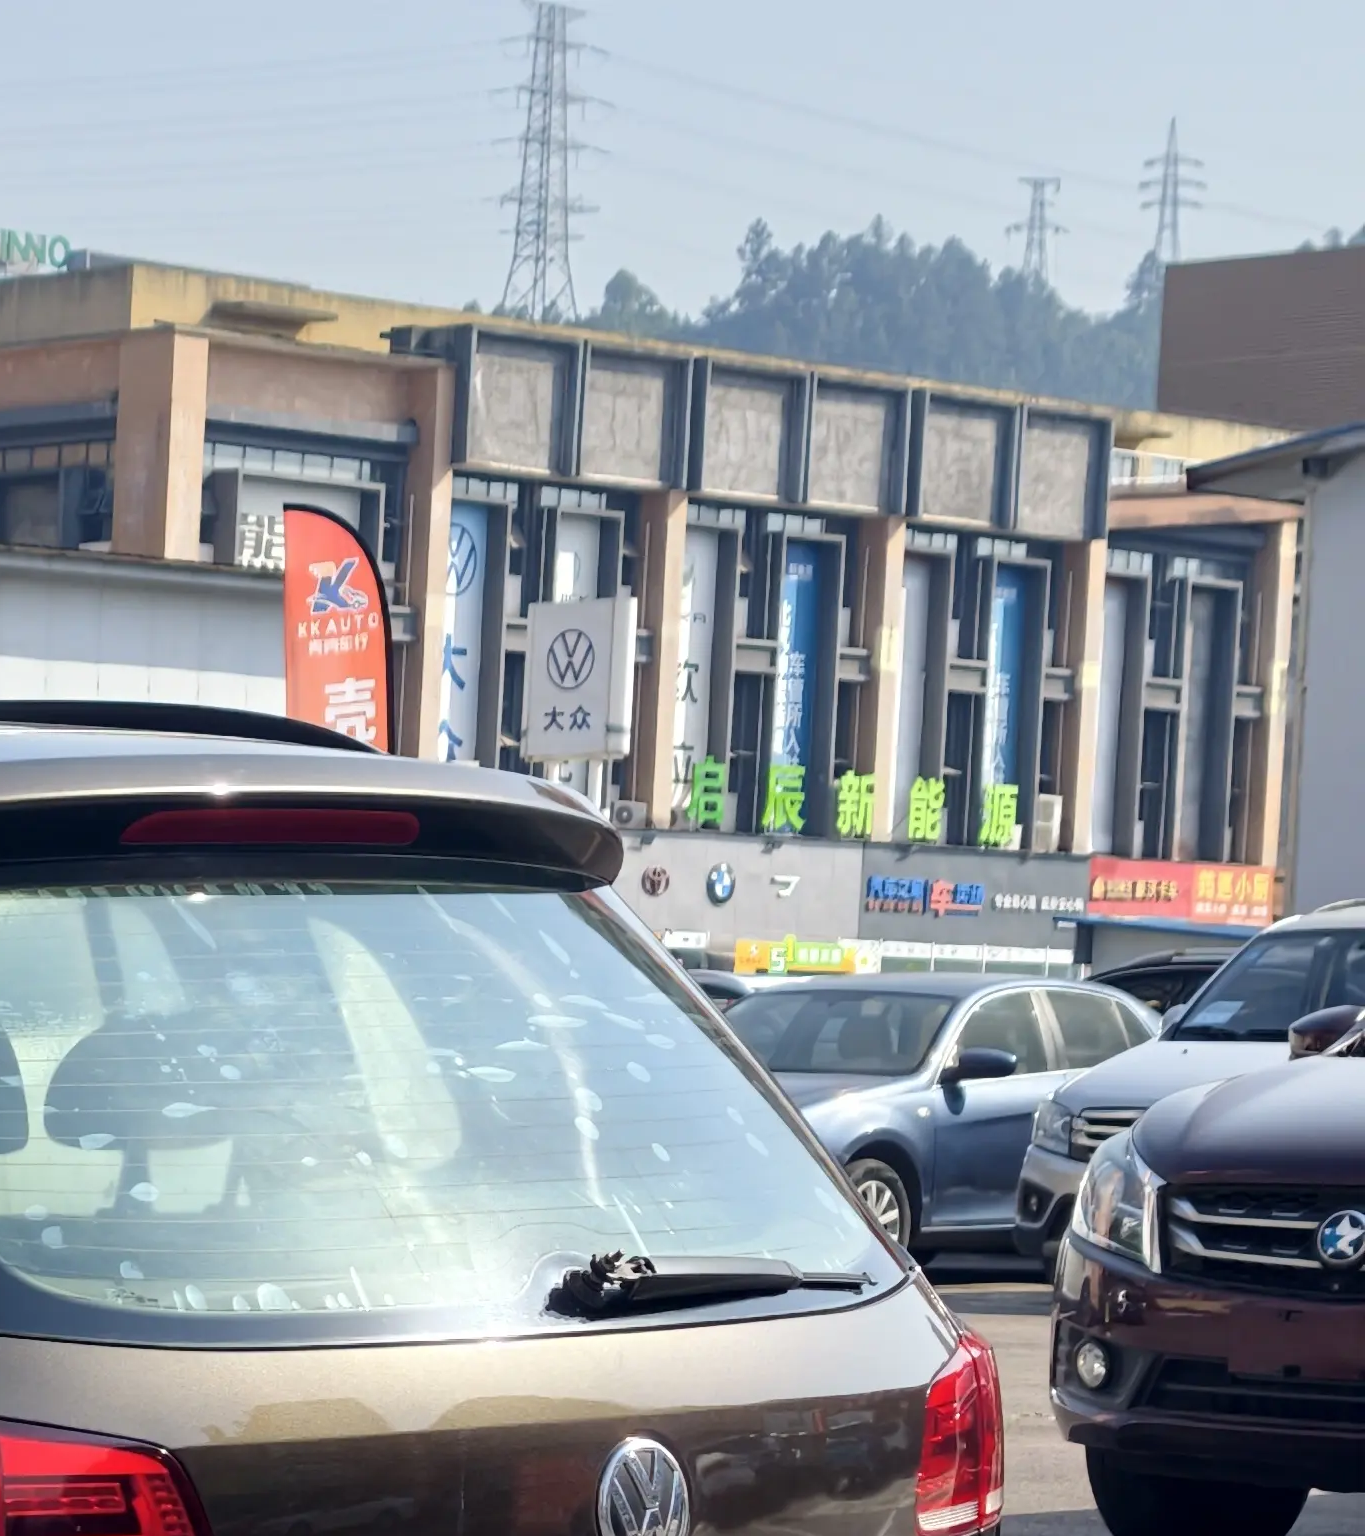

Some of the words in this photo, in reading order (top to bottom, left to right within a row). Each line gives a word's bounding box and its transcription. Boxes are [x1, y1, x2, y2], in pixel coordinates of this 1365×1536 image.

[544, 704, 591, 731] 大众
[687, 755, 1019, 849] 启辰新能源
